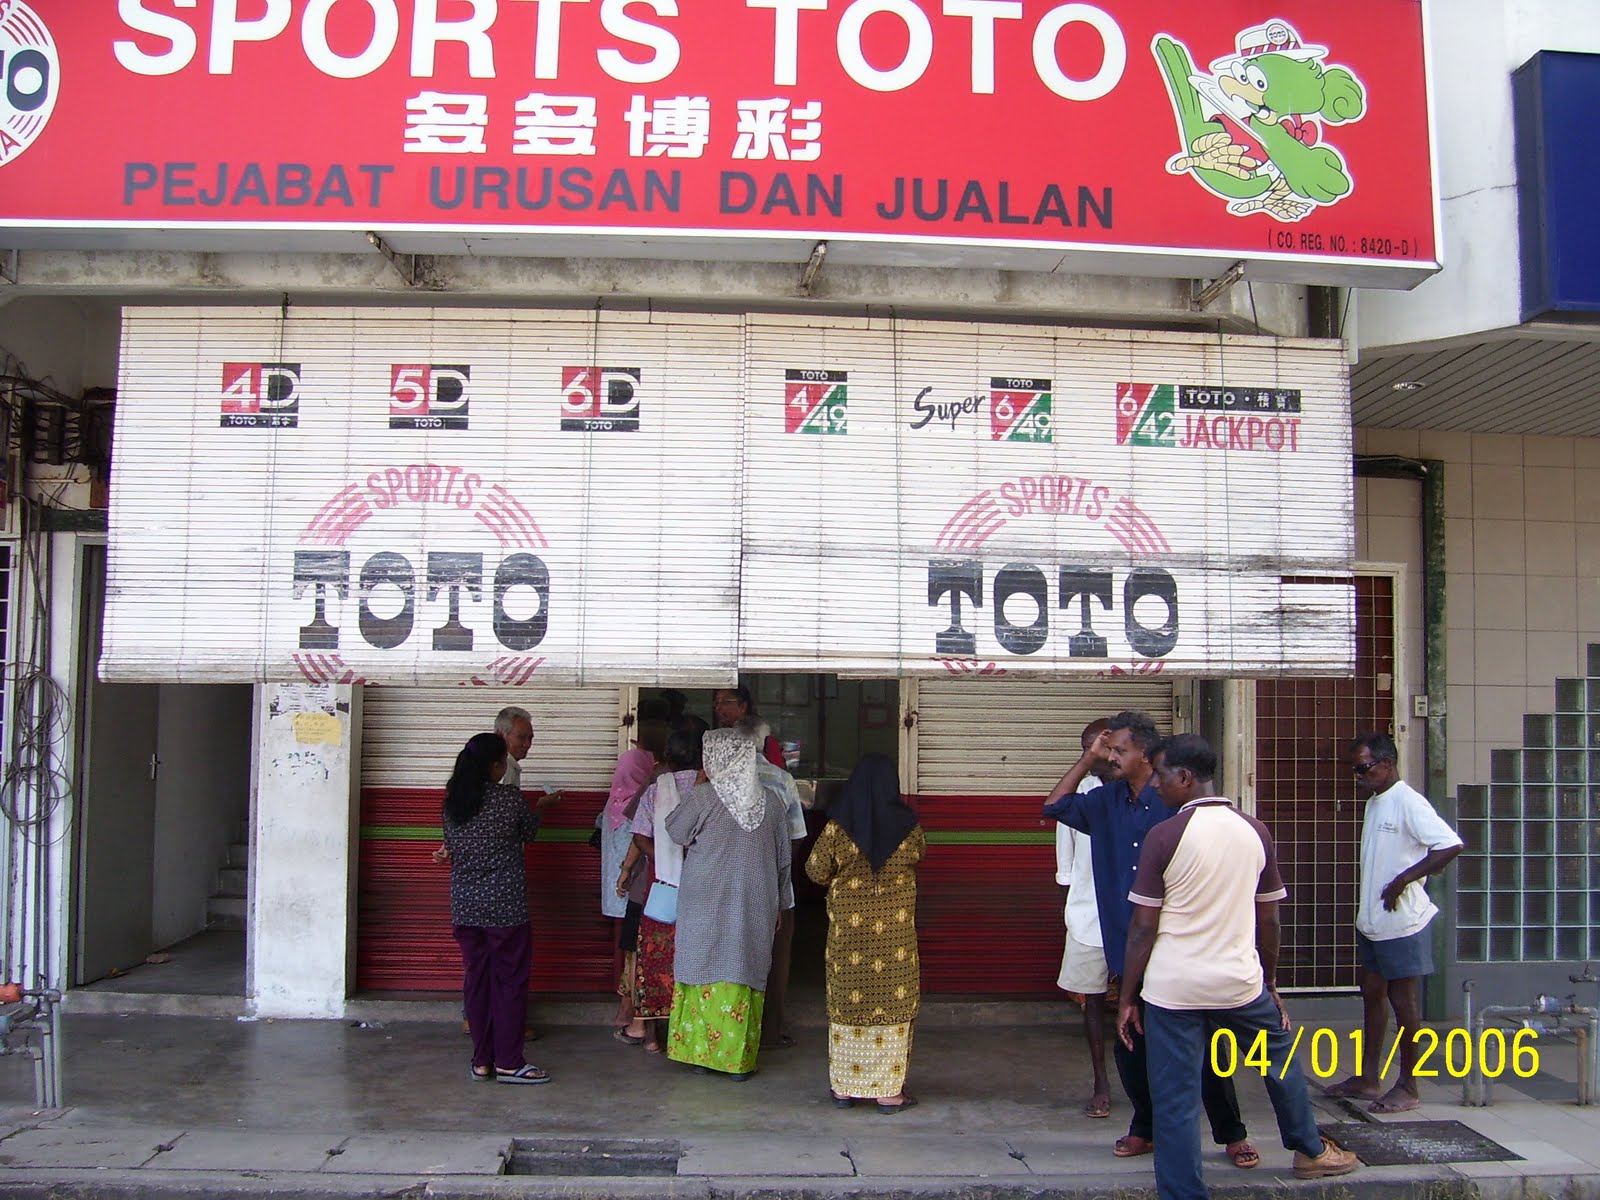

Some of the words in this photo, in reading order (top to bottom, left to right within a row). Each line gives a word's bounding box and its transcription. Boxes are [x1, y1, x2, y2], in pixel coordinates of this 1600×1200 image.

[113, 0, 681, 84] SPORTS
[745, 0, 1128, 102] TOTO
[403, 91, 823, 162] 多多博彩
[122, 162, 394, 207] PEJABAT
[429, 165, 681, 213] URUSAN
[719, 170, 843, 218] DAN
[876, 177, 1113, 229] JUALAN
[1300, 233, 1325, 251] REG.
[221, 367, 301, 409] 4D
[390, 369, 470, 410] 5D
[561, 371, 641, 413] 6D
[800, 370, 829, 380] TOTO
[1006, 378, 1034, 388] TOTO
[910, 385, 986, 431] Super
[1185, 389, 1236, 405] TOTO
[229, 415, 257, 426] TOTO
[414, 418, 442, 428] TOTO
[584, 420, 613, 430] TOTO
[1179, 414, 1301, 452] JACKPOT
[366, 464, 483, 510] SPORTS
[999, 474, 1110, 521] SPORTS
[293, 550, 550, 651] TOTO
[927, 558, 1179, 658] TOTO
